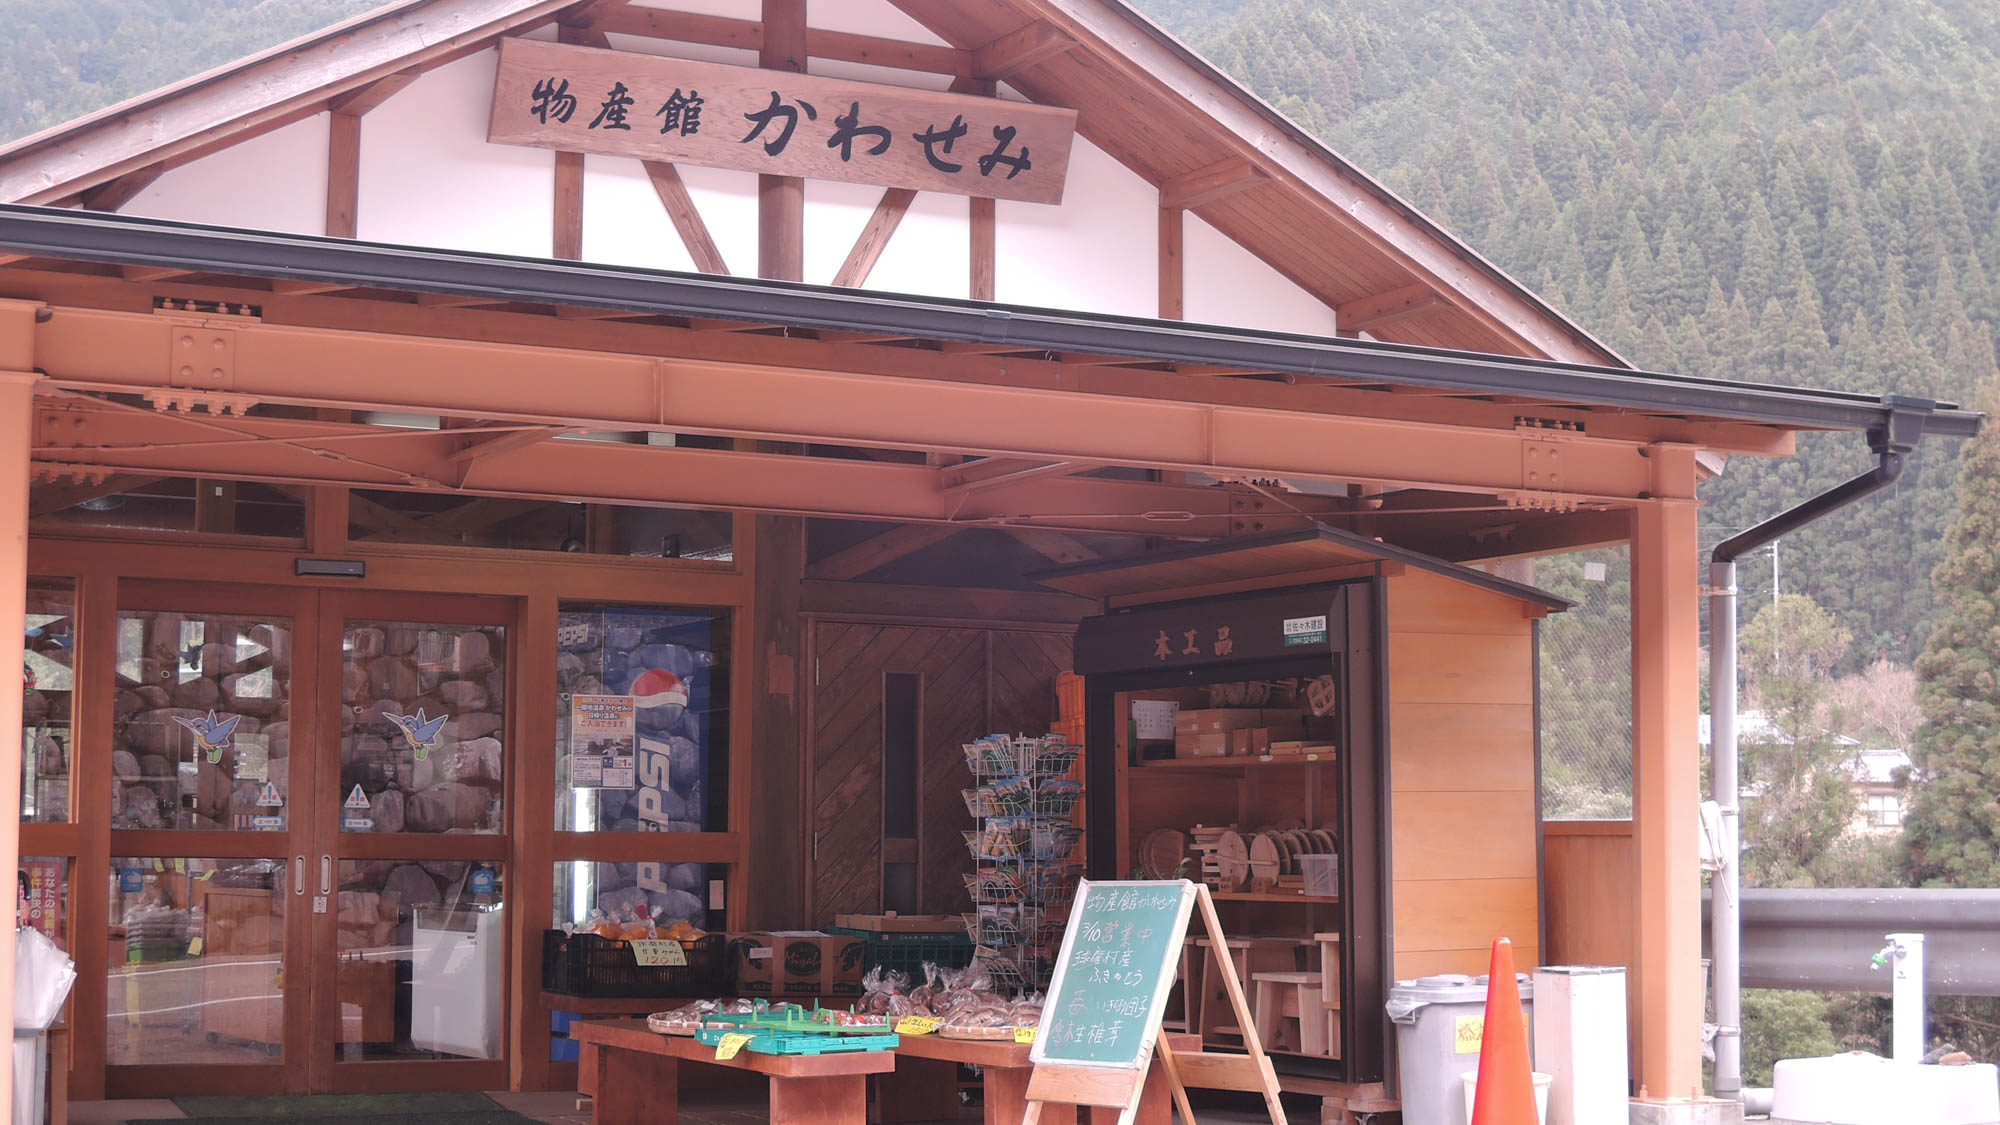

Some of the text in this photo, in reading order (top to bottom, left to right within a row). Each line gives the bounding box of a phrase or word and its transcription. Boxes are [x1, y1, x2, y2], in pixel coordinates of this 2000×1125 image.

[529, 77, 1033, 181] 物産館 かわせみ
[1154, 625, 1233, 661] 木工品
[1088, 967, 1144, 986] ふきのとう
